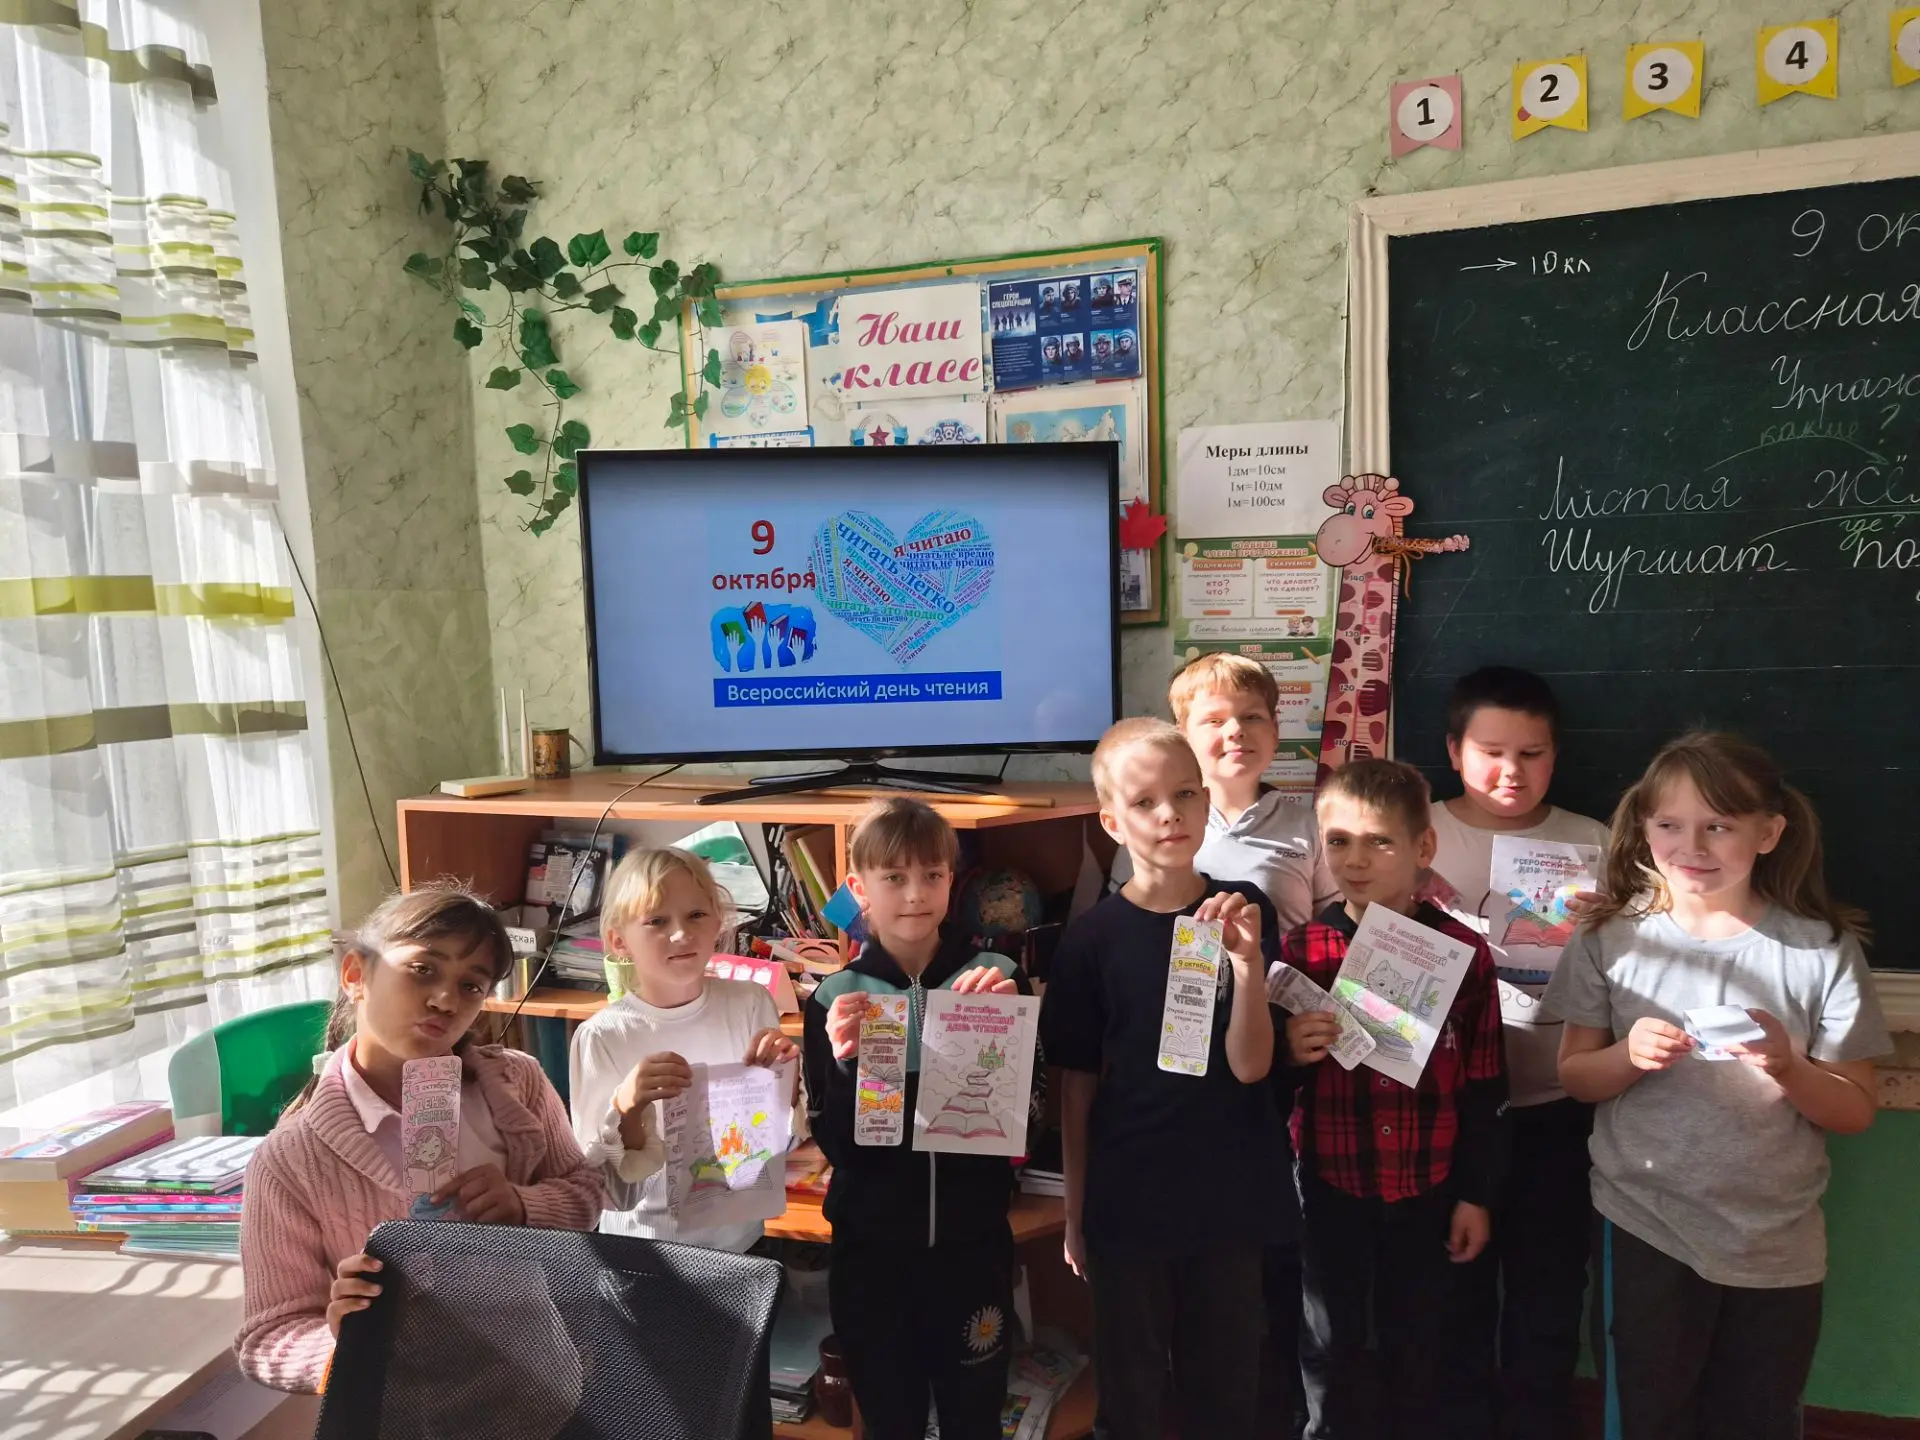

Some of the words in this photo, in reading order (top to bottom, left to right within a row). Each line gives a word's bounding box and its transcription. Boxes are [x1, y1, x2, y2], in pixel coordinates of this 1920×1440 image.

[1786, 41, 1808, 70] 4
[1540, 74, 1559, 103] 2
[1648, 62, 1668, 90] 3
[1418, 97, 1435, 125] 1
[1792, 209, 1825, 257] 9
[1627, 271, 1920, 351] Классная
[856, 311, 964, 347] Наш
[843, 357, 980, 389] класс
[1205, 445, 1251, 461] Меры
[1256, 444, 1309, 458] длины
[1228, 464, 1286, 477] 1дм=10см
[1230, 481, 1283, 492] 1м=10дм
[1227, 497, 1286, 508] 1м=100см
[751, 520, 775, 555] 9
[908, 528, 972, 552] читаю
[712, 566, 816, 594] октября
[837, 521, 899, 575] читать
[901, 571, 956, 614] легко
[1541, 526, 1788, 613] Шуршат
[727, 681, 870, 704] Всероссийский
[874, 685, 920, 701] день
[924, 680, 989, 697] чтения
